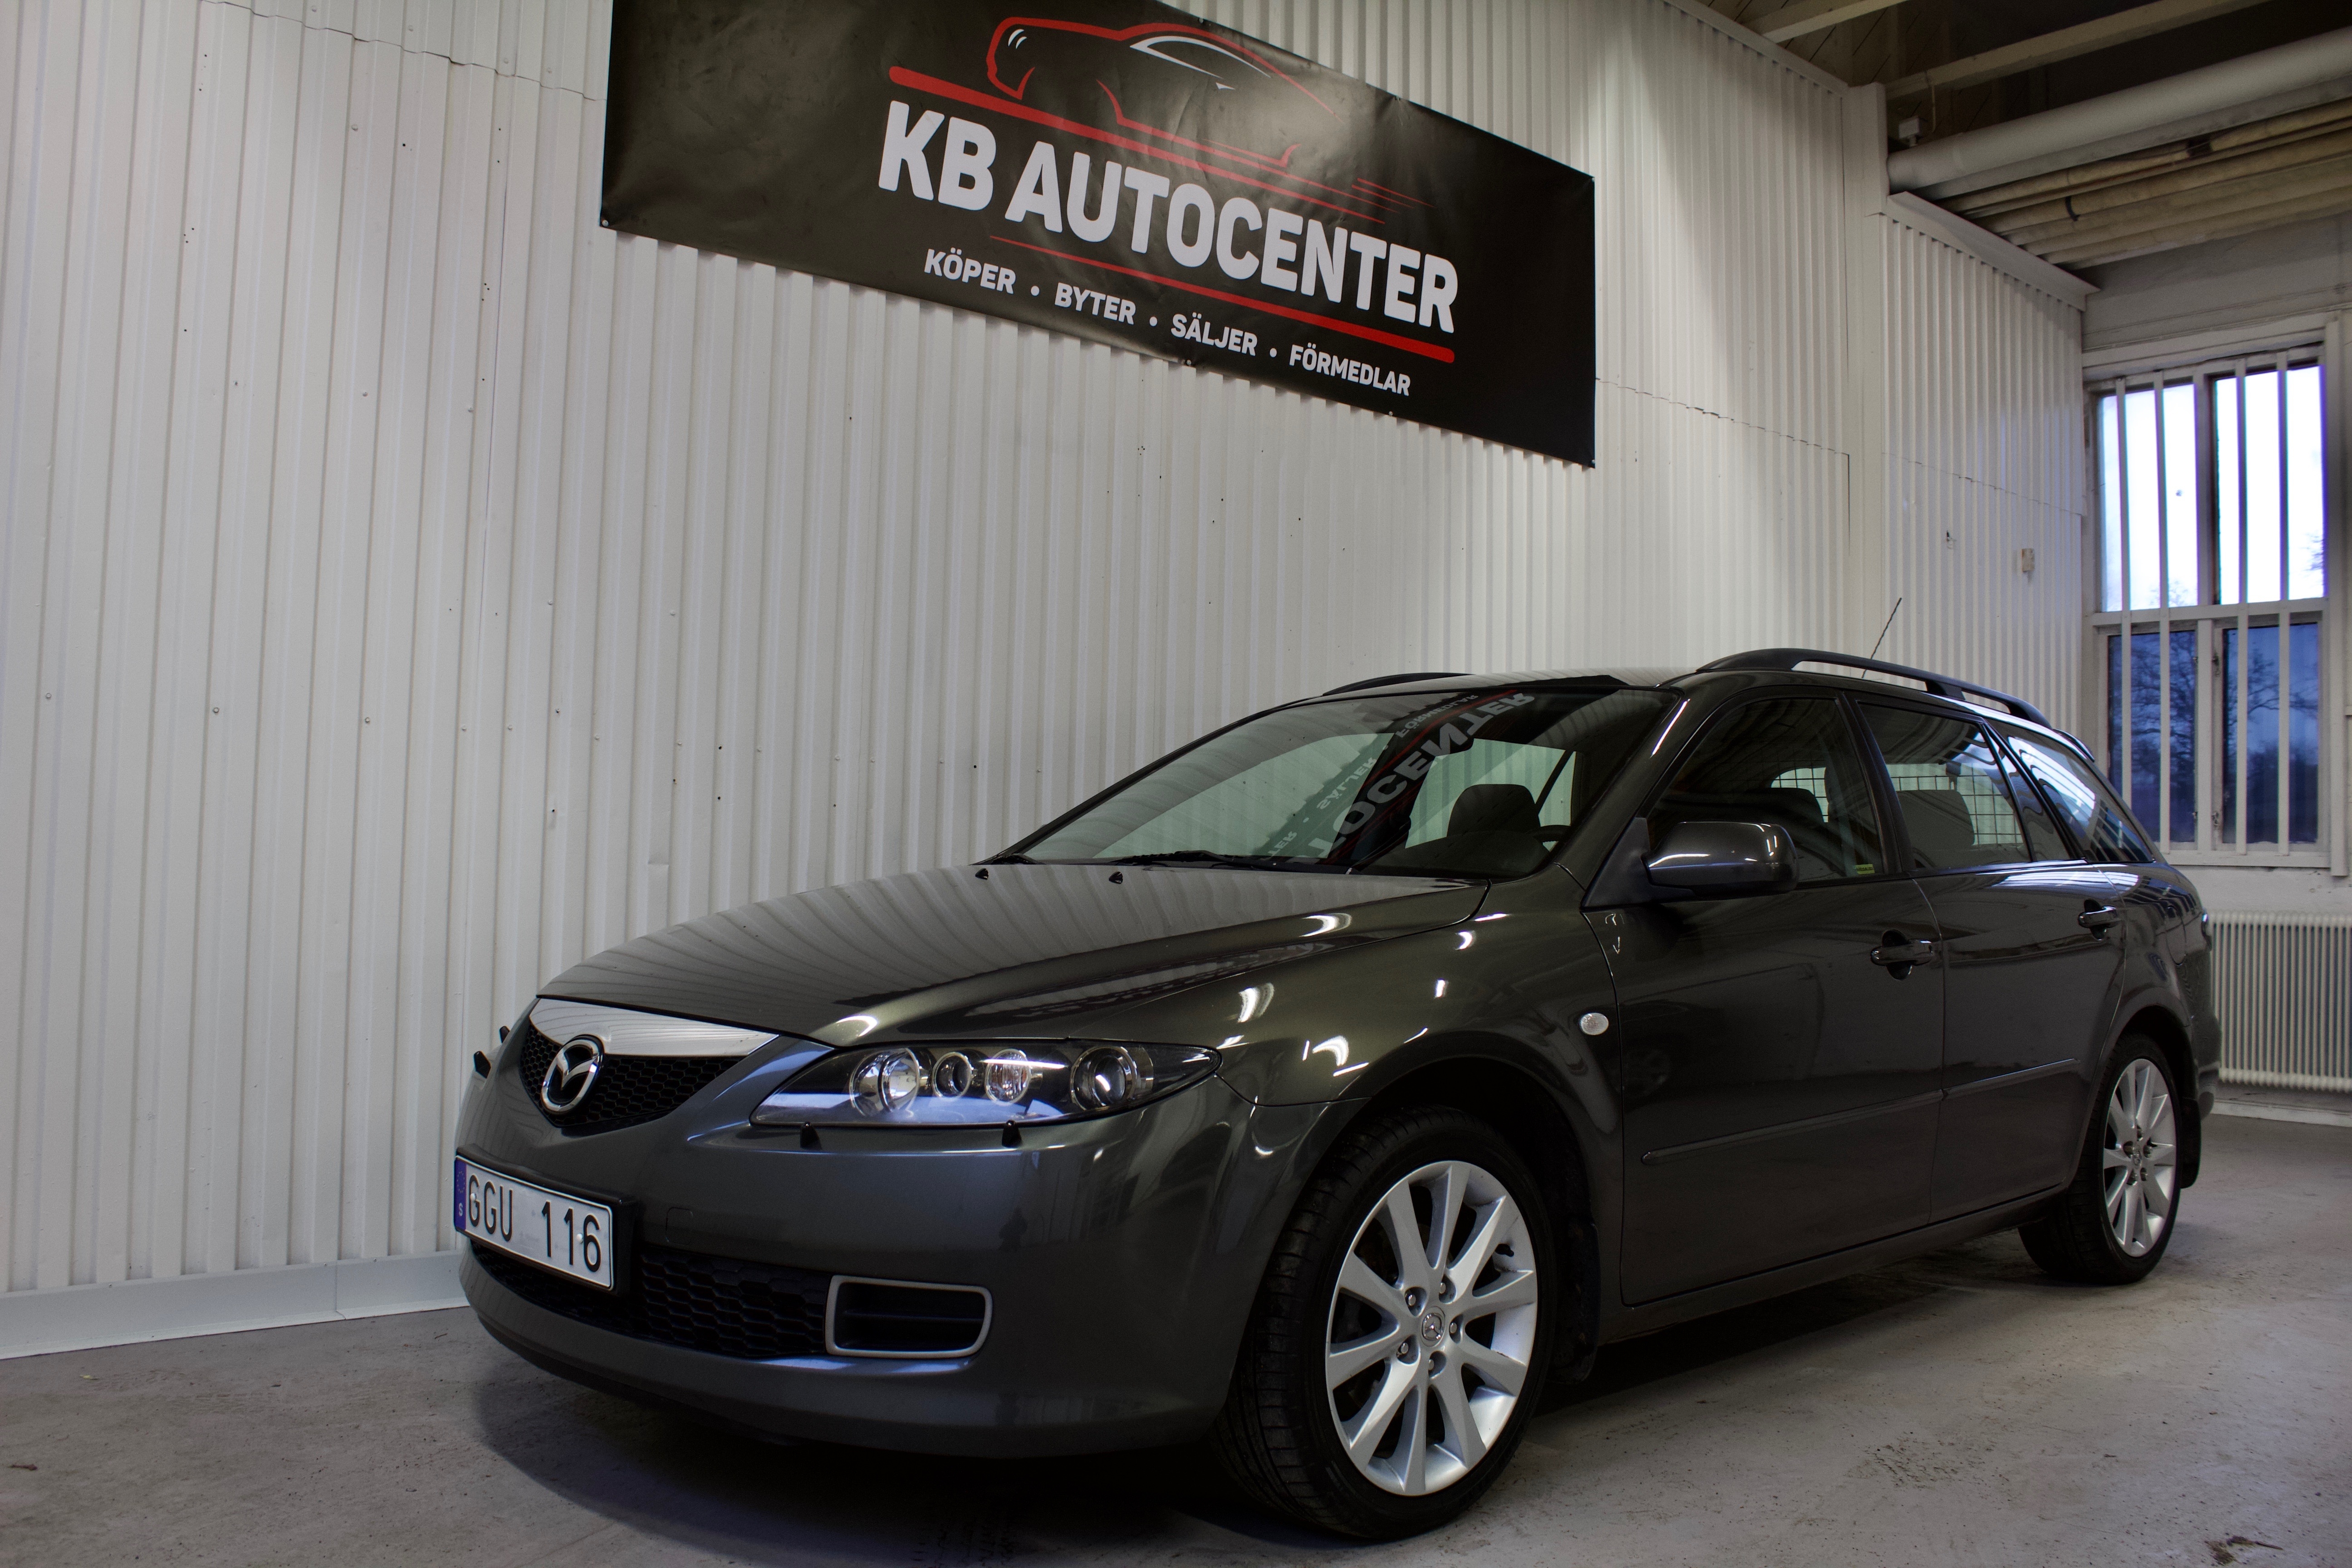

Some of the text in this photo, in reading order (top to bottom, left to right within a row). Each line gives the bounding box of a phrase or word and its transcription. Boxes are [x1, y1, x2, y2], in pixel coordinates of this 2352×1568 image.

[878, 100, 1458, 333] KB AUTOCENTER
[924, 247, 1411, 397] KÖPER BYTER SÄLJER FÖRMEDLAR
[458, 1202, 463, 1216] S
[469, 1174, 601, 1272] GGU 116
